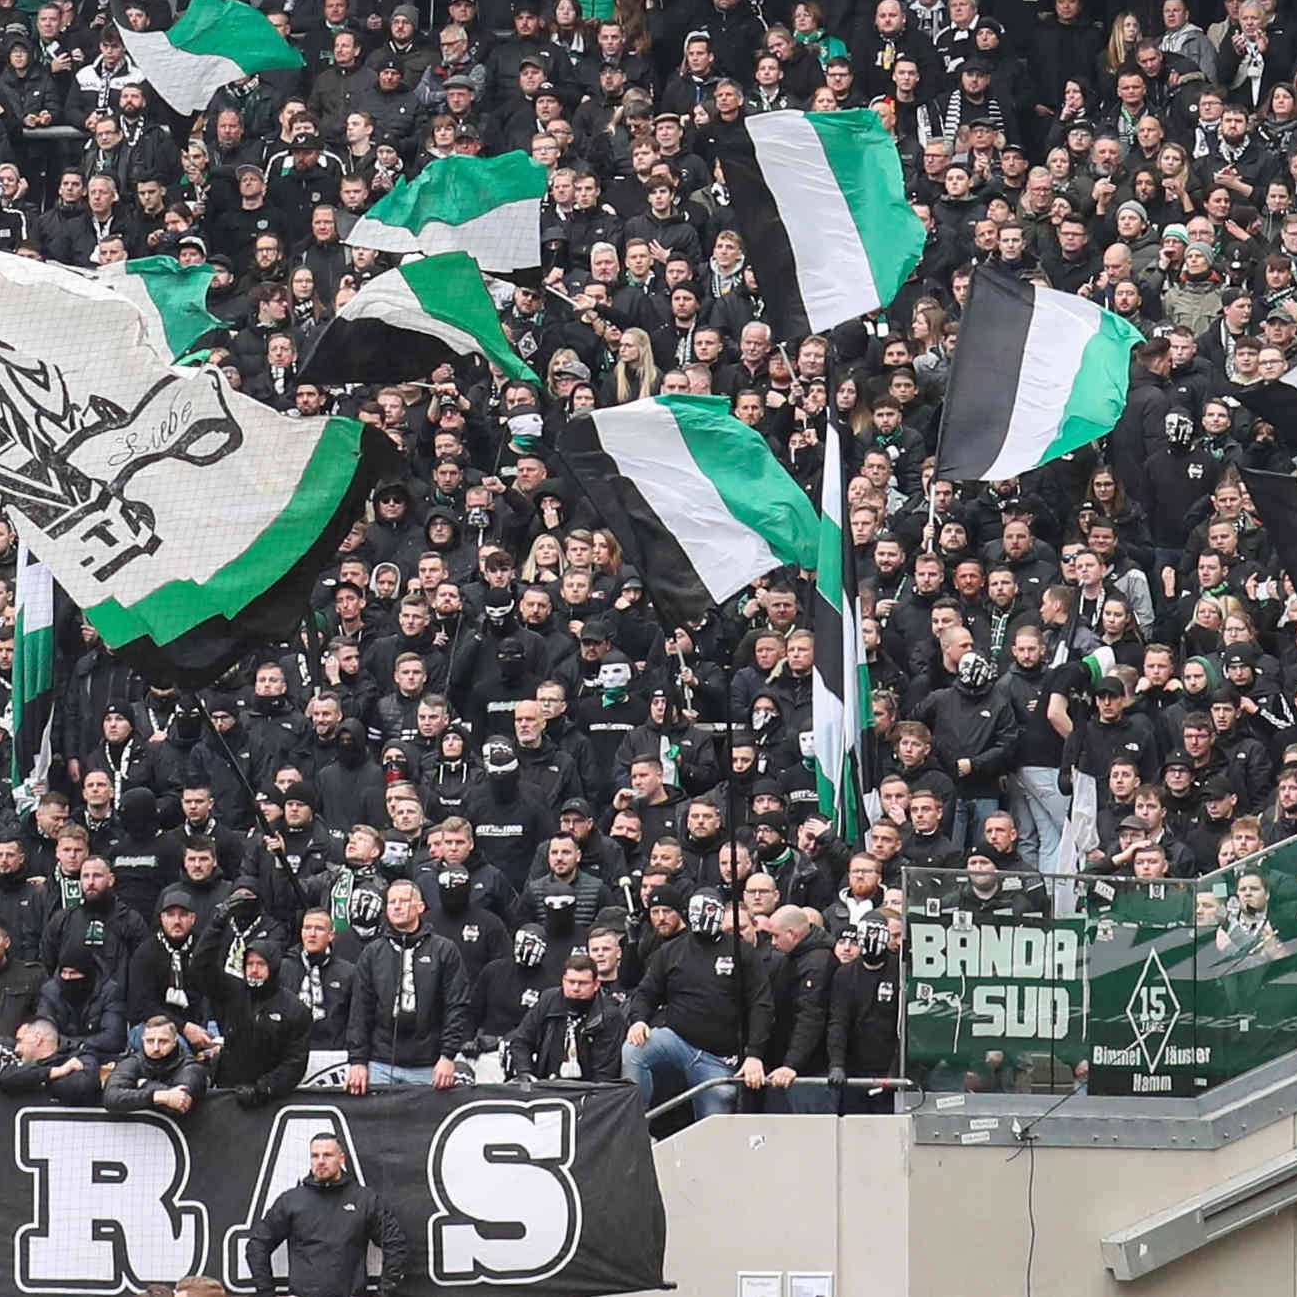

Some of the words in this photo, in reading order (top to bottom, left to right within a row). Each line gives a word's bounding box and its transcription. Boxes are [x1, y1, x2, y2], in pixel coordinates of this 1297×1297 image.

[910, 922, 1078, 981] BANDA
[971, 985, 1070, 1039] SUD
[1139, 986, 1167, 1021] 15
